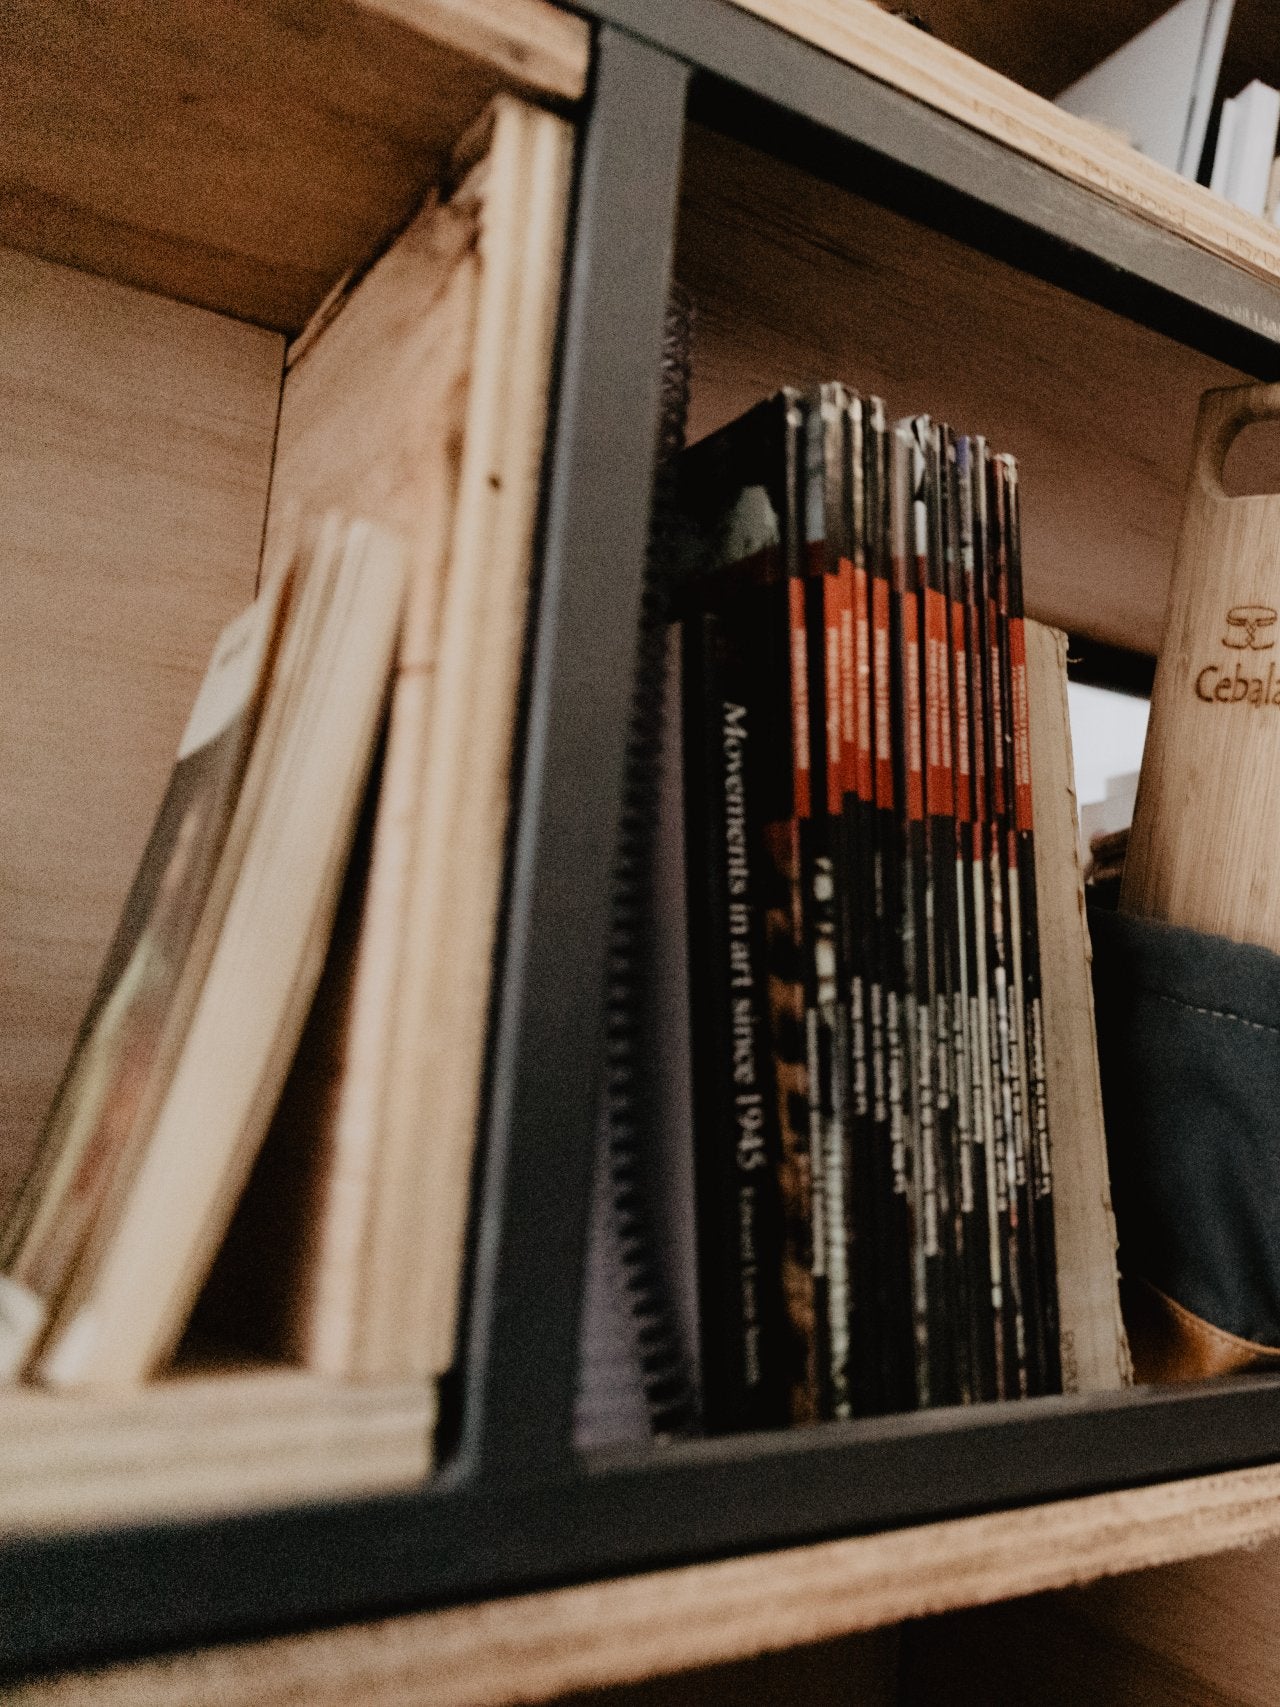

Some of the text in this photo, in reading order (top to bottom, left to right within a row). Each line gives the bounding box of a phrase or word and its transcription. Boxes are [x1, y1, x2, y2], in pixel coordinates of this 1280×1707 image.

[723, 701, 749, 895] Movements
[729, 902, 750, 935] in
[730, 940, 754, 988] art
[732, 998, 758, 1085] since
[735, 1094, 767, 1171] 1945
